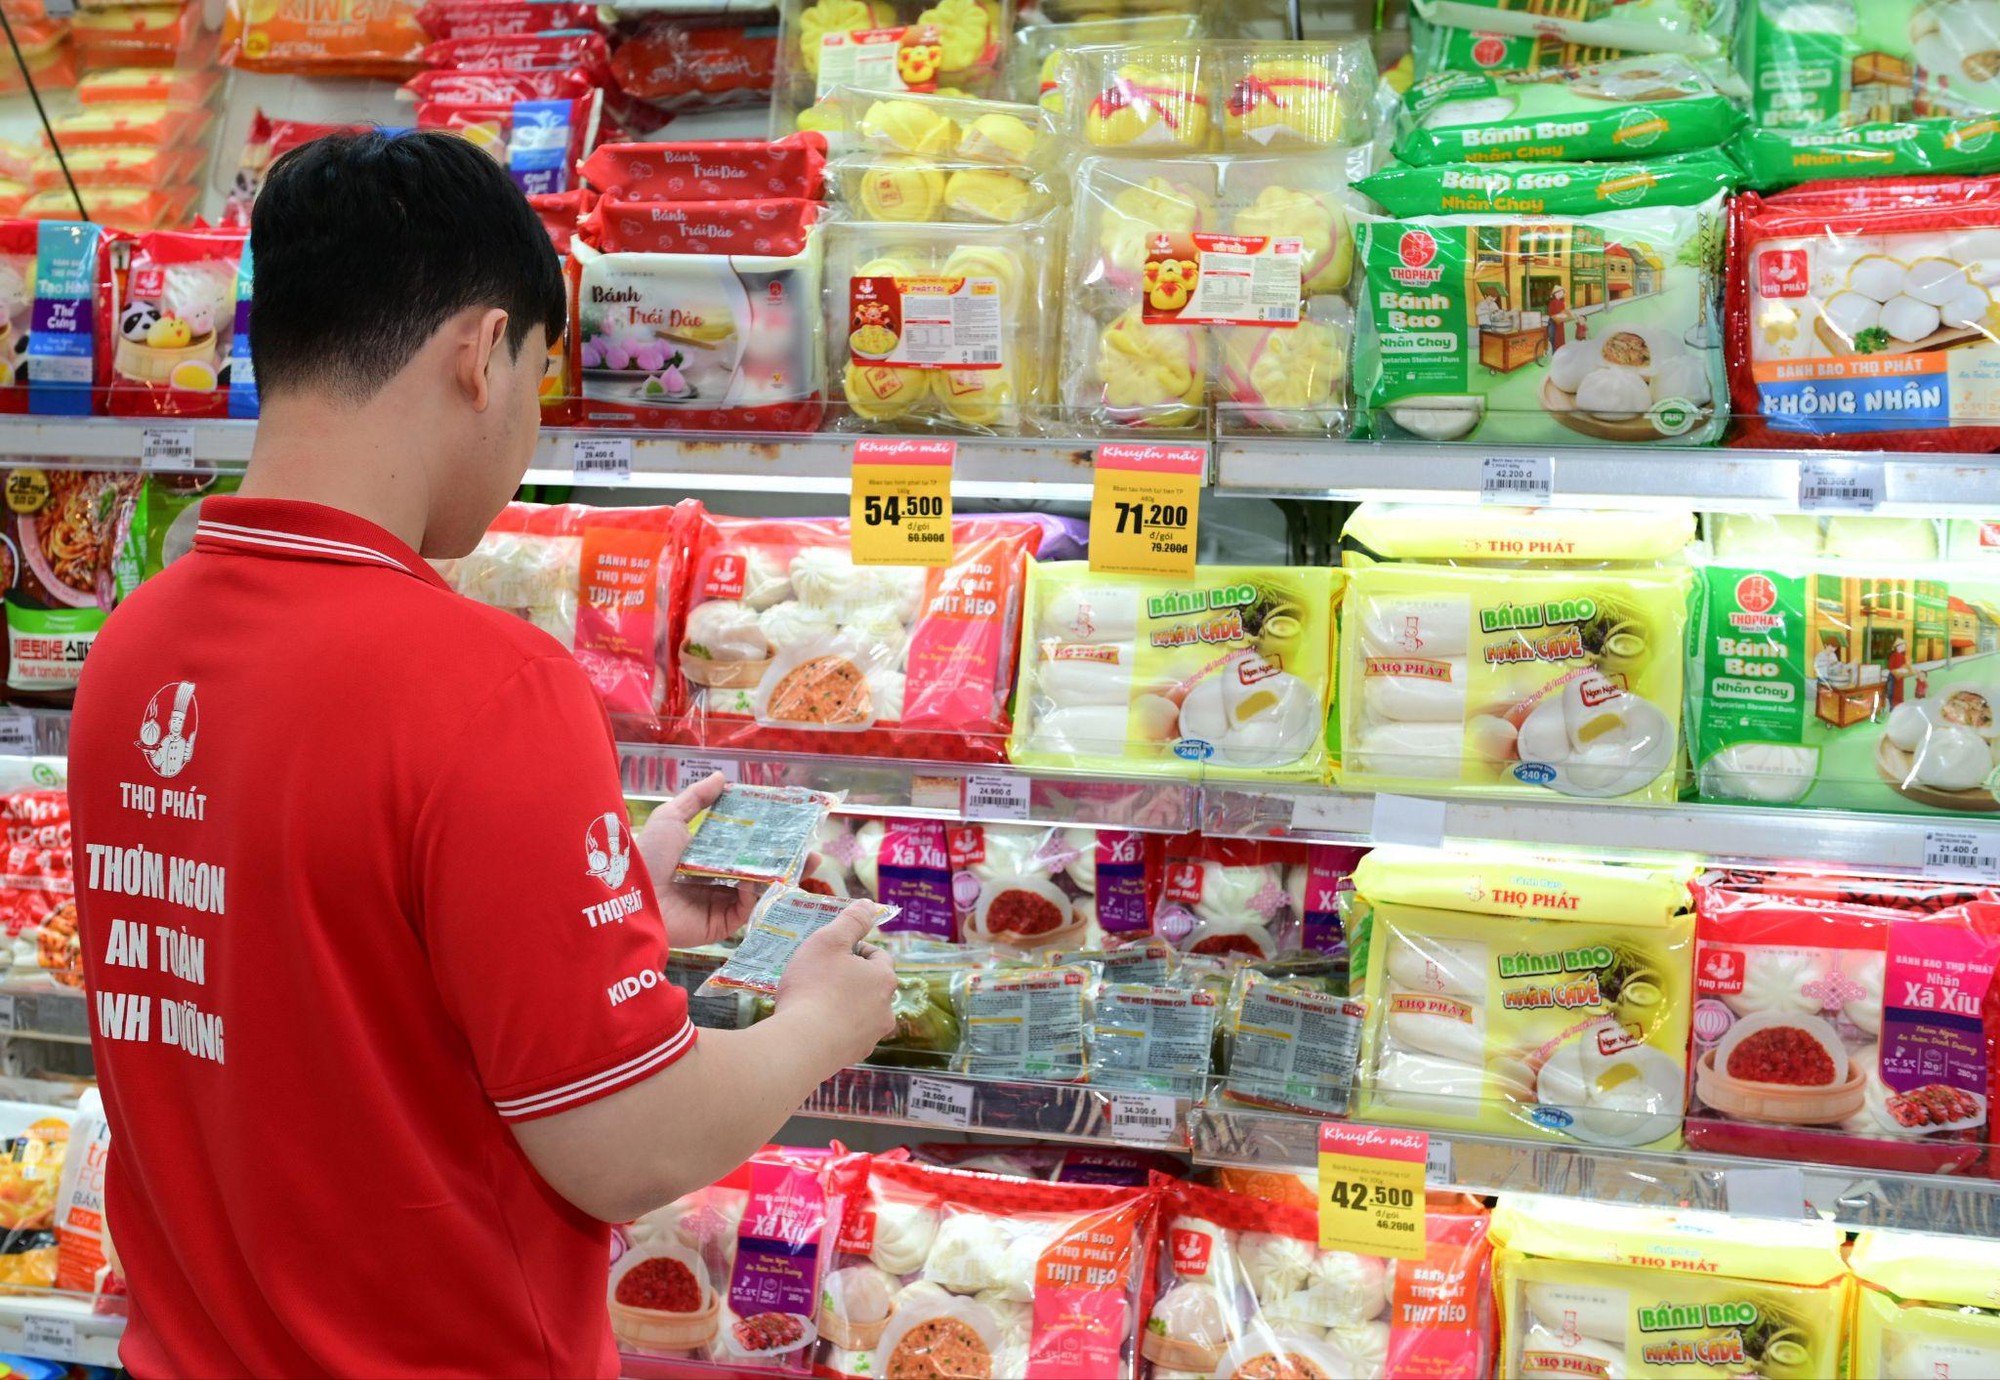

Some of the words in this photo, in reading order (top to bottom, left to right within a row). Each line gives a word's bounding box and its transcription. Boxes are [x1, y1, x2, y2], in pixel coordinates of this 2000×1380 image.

[1462, 126, 1531, 146] Bánh
[1537, 121, 1589, 139] Bao
[664, 151, 700, 163] Bánh
[1517, 145, 1564, 159] Chay
[692, 164, 720, 178] Trái
[720, 164, 748, 178] Đào
[1516, 173, 1571, 190] Bao
[1442, 196, 1491, 211] Nhân
[1494, 197, 1544, 212] Chay
[652, 208, 688, 222] Bánh
[679, 224, 707, 237] Trái
[707, 224, 734, 238] Đào
[592, 286, 642, 302] Bánh
[1762, 284, 1780, 294] THỌ
[1782, 281, 1808, 293] PHÁT
[52, 303, 76, 316] Thú
[1379, 292, 1449, 310] Bánh
[628, 306, 663, 326] Trái
[669, 308, 704, 326] Đào
[1388, 311, 1442, 328] Bao
[1380, 336, 1413, 347] Nhân
[1417, 338, 1451, 349] Chay
[1818, 362, 1845, 374] BAO
[1850, 360, 1880, 377] THỌ
[1884, 357, 1924, 373] PHÁT
[1763, 385, 1856, 415] KHÔNG
[1864, 381, 1941, 411] NHÂN
[859, 440, 918, 456] Khuyến
[920, 442, 951, 453] mãi
[1103, 446, 1162, 460] Khuyến
[1168, 451, 1199, 461] mãi
[1496, 470, 1524, 478] 42.200
[1115, 502, 1188, 534] 71.200
[908, 523, 930, 531] đ/gói
[1150, 532, 1173, 541] đ/gói
[1489, 541, 1523, 553] THỌ
[1528, 541, 1575, 553] PHÁT
[596, 570, 620, 583] THỌ
[721, 581, 742, 594] PHÁT
[1148, 590, 1207, 618] BÁNH
[1209, 584, 1257, 610] BAO
[1480, 601, 1543, 632] BÁNH
[1544, 597, 1597, 625] BAO
[1485, 638, 1536, 664] NHÂN
[1718, 638, 1788, 658] Bánh
[1724, 658, 1780, 677] Bao
[1716, 681, 1751, 694] Nhân
[1754, 686, 1788, 698] Chay
[1181, 747, 1198, 757] 240
[1521, 771, 1541, 780] 240
[120, 781, 155, 819] THỌ
[161, 785, 207, 821] PHÁT
[1940, 845, 1969, 853] 21.400
[86, 844, 164, 900] THƠM
[169, 856, 226, 915] NGON
[1492, 890, 1527, 907] THỌ
[1532, 893, 1580, 909] PHÁT
[582, 899, 624, 928] THỌ
[104, 919, 148, 970] AN
[156, 925, 205, 985] TOÀN
[1497, 949, 1562, 978] BÁNH
[1563, 945, 1613, 973] BAO
[1699, 978, 1715, 990] THỌ
[1717, 979, 1741, 990] PHÁT
[1927, 972, 1960, 987] Nhân
[1504, 986, 1553, 1010] NHÂN
[1397, 999, 1425, 1012] THỌ
[1428, 1001, 1468, 1017] PHÁT
[161, 997, 225, 1065] DƯỠNG
[1324, 1128, 1386, 1146] Khuyến
[1390, 1136, 1423, 1148] mãi
[1332, 1181, 1413, 1211] 42.500
[1092, 1233, 1114, 1244] BAO
[1056, 1246, 1080, 1260] THỌ
[1083, 1248, 1116, 1262] PHÁT
[1629, 1255, 1665, 1268] THỌ
[1671, 1257, 1719, 1272] PHÁT
[1047, 1263, 1082, 1282] THỊT
[1086, 1267, 1117, 1284] HEO
[1439, 1302, 1467, 1322] HEO
[1639, 1301, 1703, 1332] BÁNH
[1704, 1302, 1758, 1328] BAO
[1643, 1337, 1695, 1365] NHÂN
